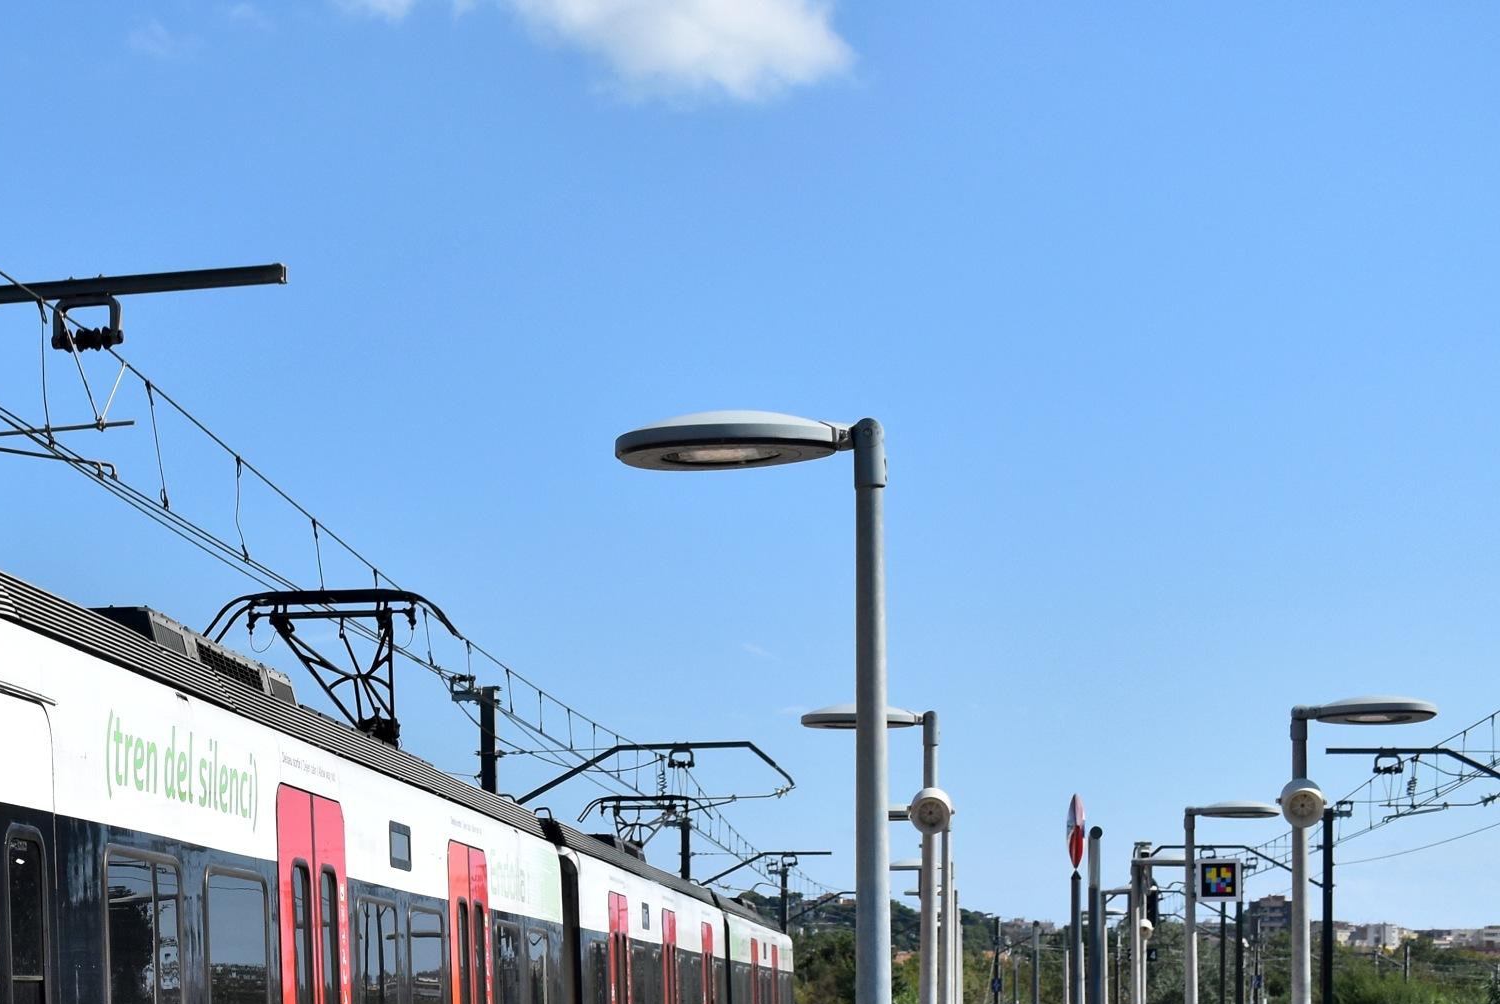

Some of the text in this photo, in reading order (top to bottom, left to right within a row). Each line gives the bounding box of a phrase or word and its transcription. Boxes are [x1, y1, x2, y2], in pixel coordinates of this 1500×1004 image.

[106, 708, 258, 832] (tren del silenci)
